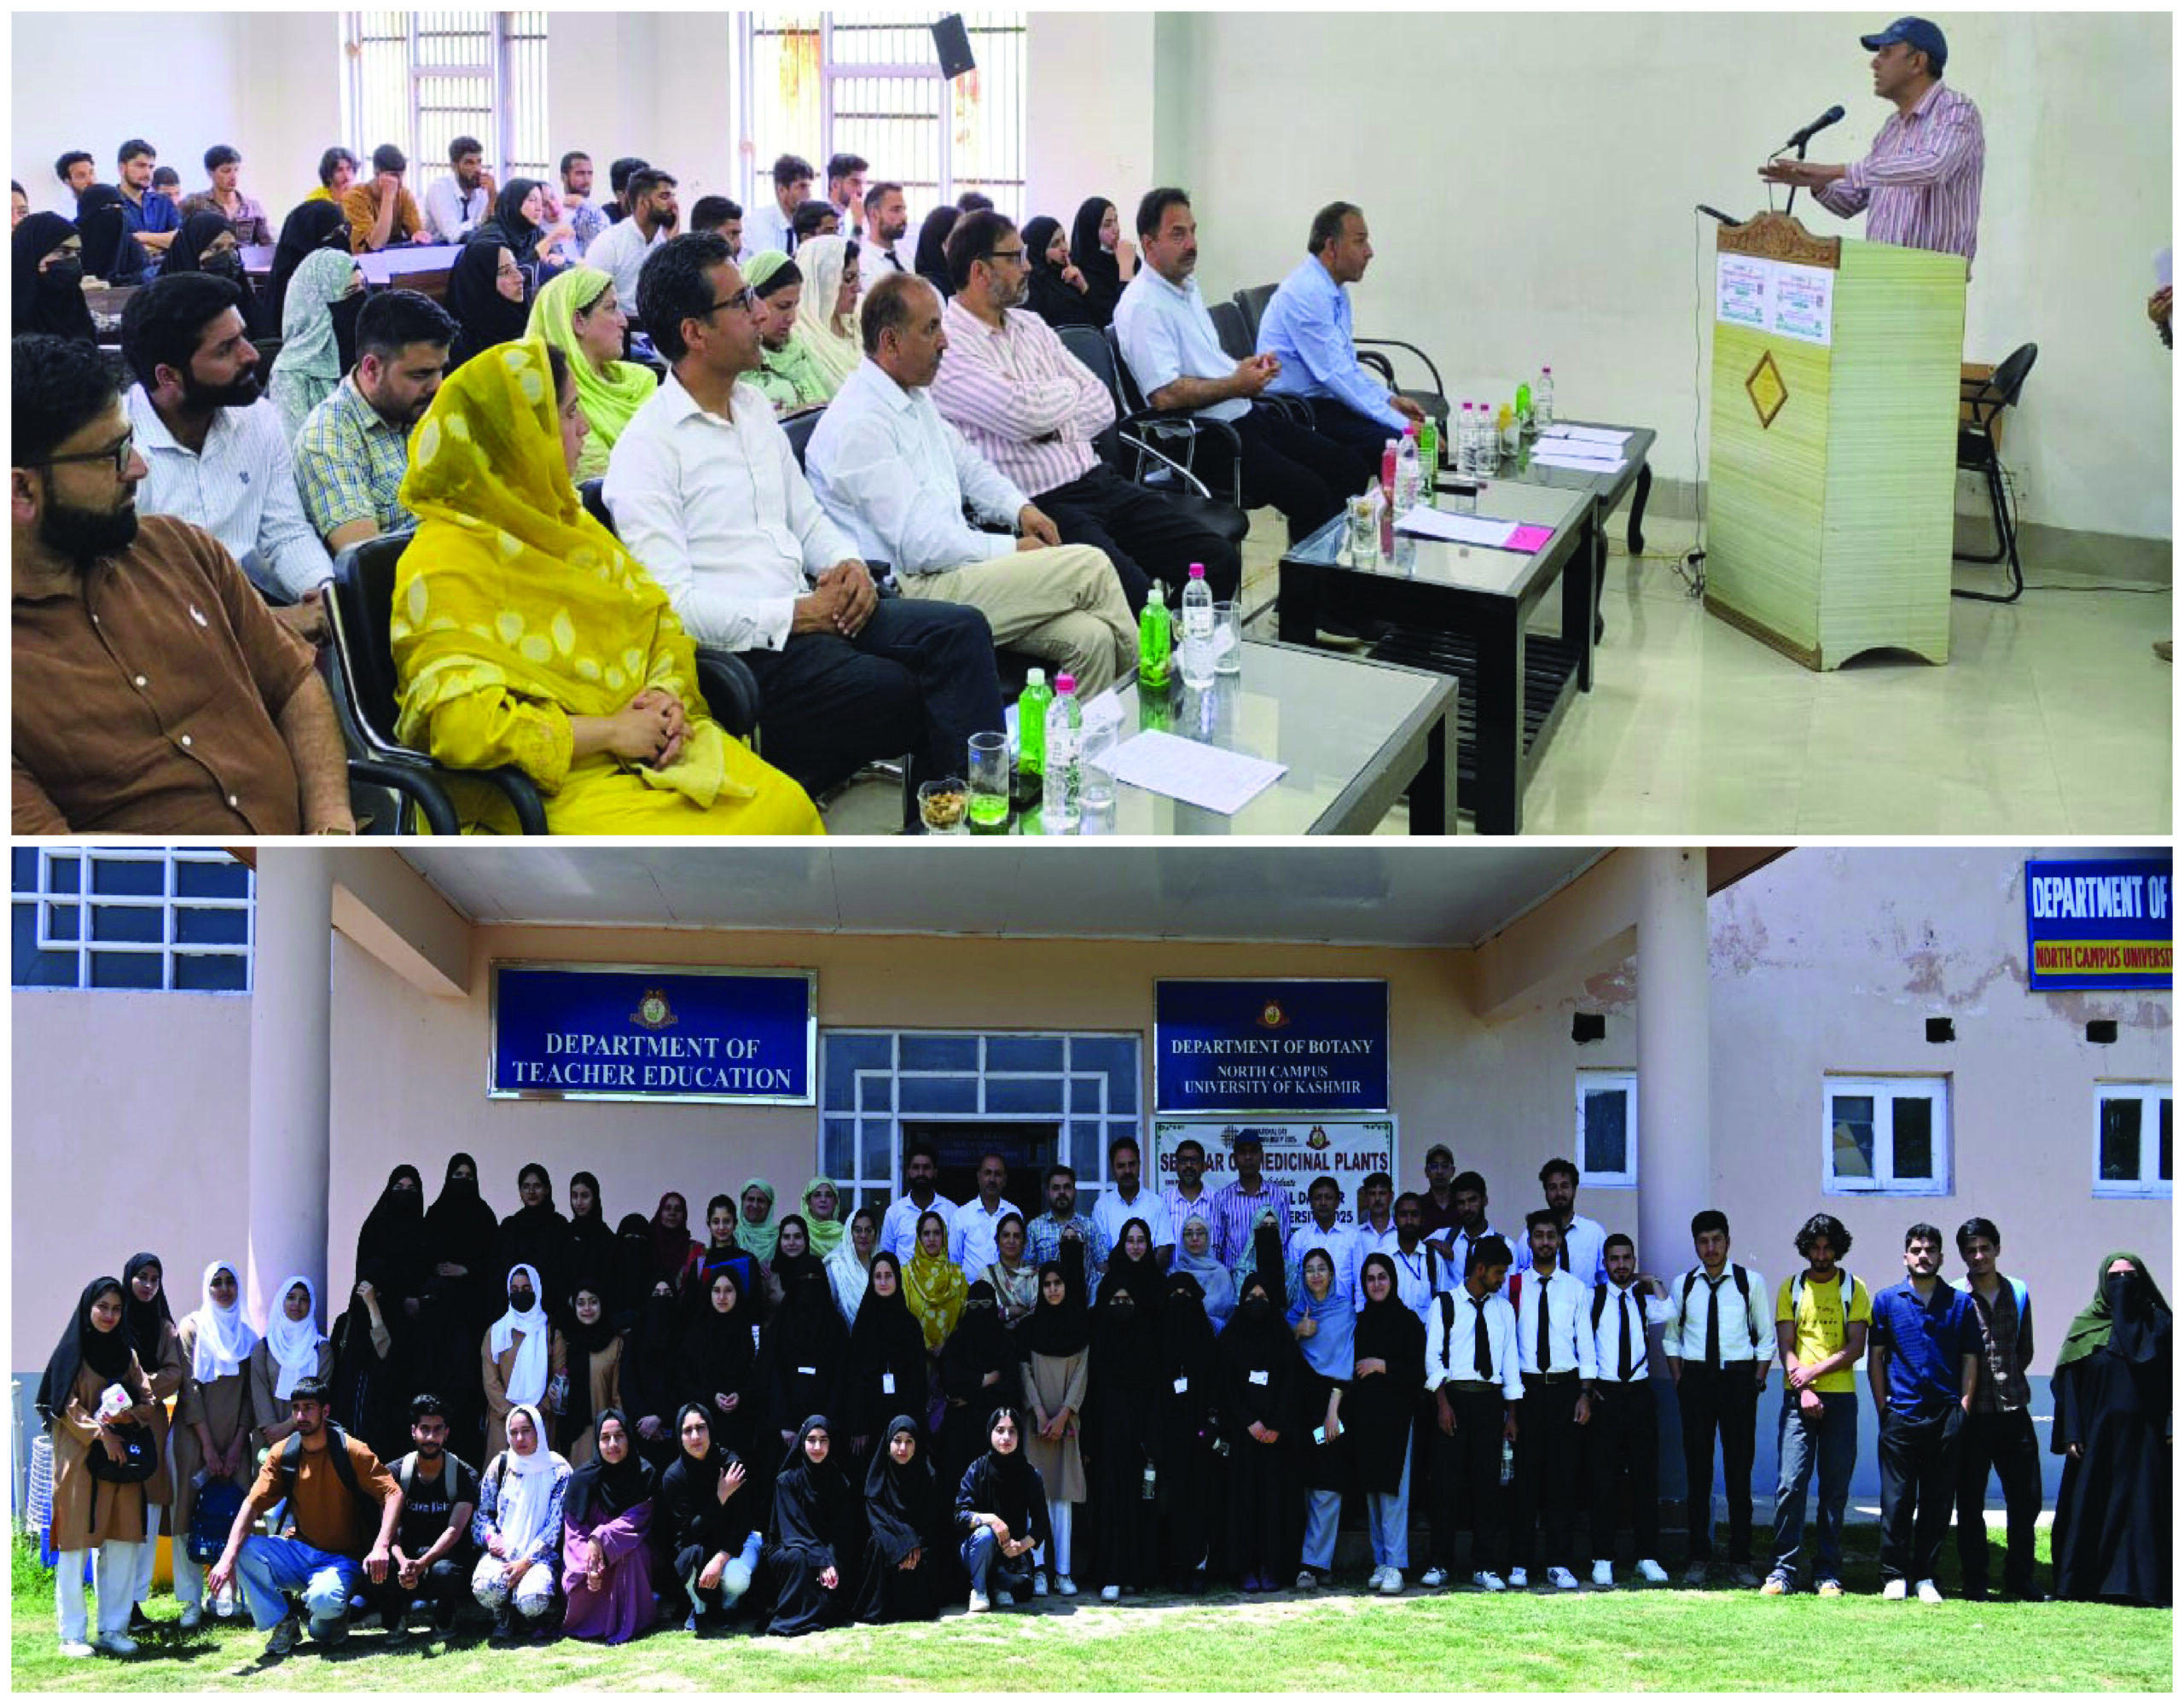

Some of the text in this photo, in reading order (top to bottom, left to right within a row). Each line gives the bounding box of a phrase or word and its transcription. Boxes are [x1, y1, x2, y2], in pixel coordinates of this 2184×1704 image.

[2032, 875, 2167, 919] DEPARTMENT OF
[2036, 946, 2173, 969] NORTH CAMPUS UNIVERSIT
[545, 1032, 759, 1059] DEPARTMENT OF
[1171, 1039, 1374, 1054] DEPARTMENT OF BOTANY
[512, 1061, 792, 1089] TEACHER EDUCATION
[1217, 1066, 1327, 1078] NORTH CAMPUS
[1185, 1080, 1362, 1094] UNIVERSITY OF KASHMIR
[1160, 1153, 1224, 1172] SEAR
[1262, 1153, 1330, 1172] EDICINAL
[1335, 1152, 1388, 1172] PLANTS
